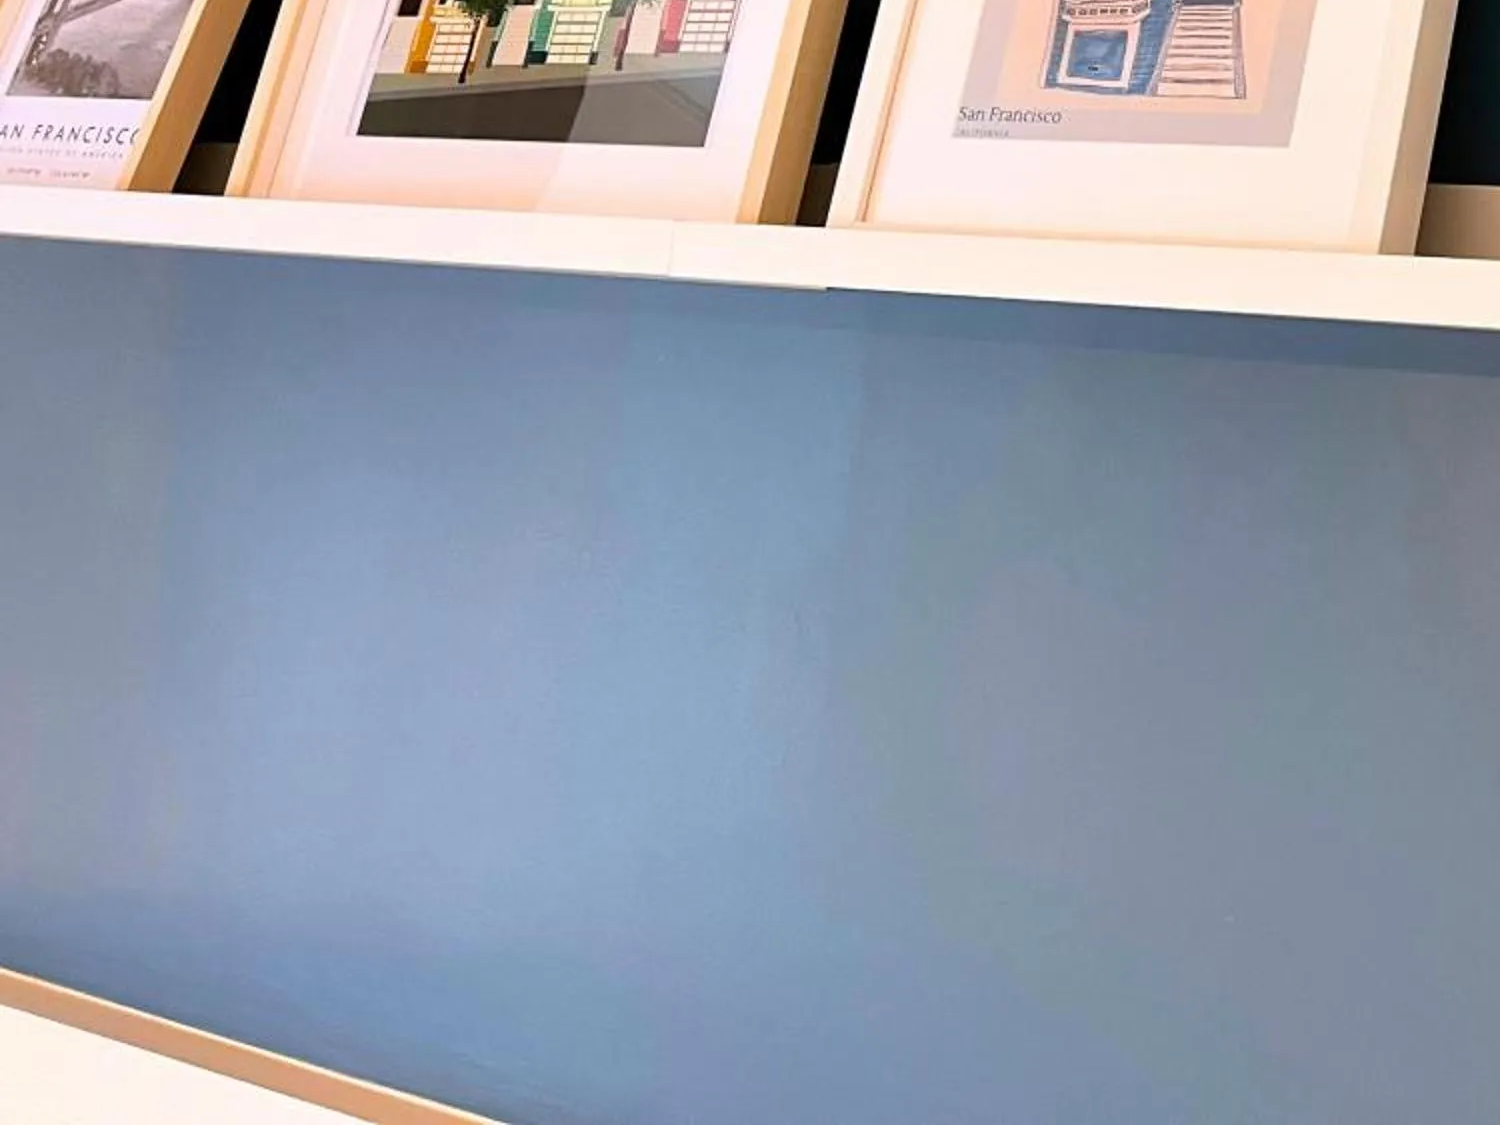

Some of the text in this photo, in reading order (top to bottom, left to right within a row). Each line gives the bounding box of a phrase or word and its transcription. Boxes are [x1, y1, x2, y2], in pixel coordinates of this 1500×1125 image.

[958, 106, 1063, 124] San Francisco
[0, 123, 25, 140] AN
